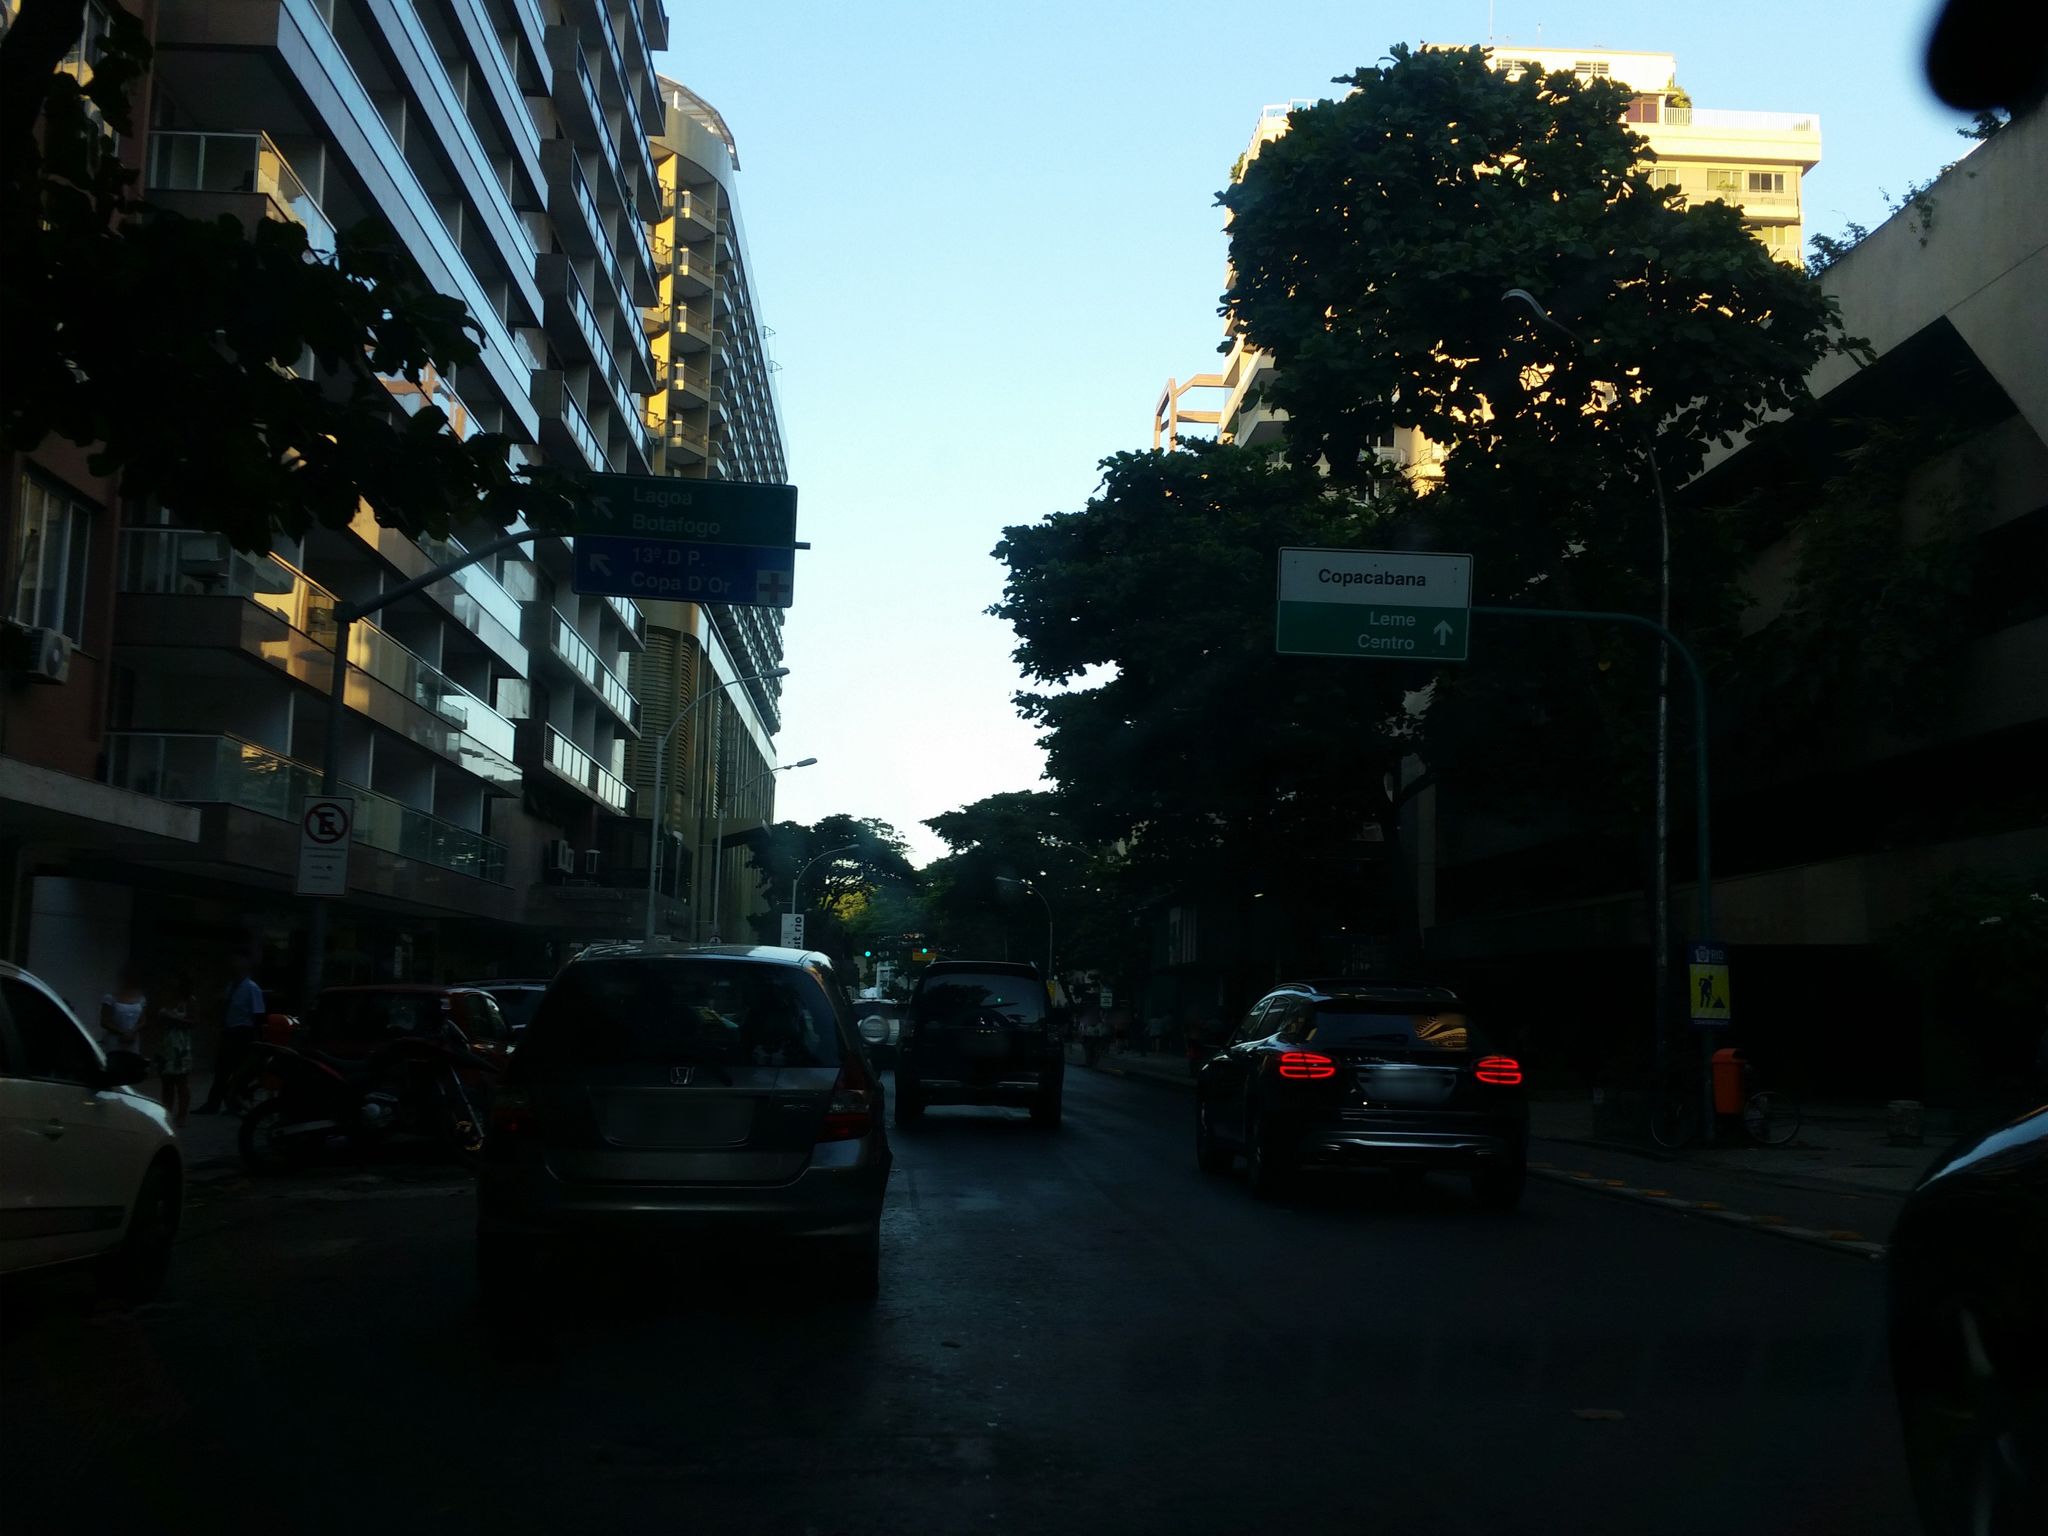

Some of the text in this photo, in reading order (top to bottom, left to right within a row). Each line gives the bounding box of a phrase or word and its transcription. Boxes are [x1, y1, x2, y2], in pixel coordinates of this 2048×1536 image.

[633, 486, 692, 508] Lagoa
[632, 513, 720, 538] Botafogo
[632, 571, 681, 592] Copa
[1319, 569, 1426, 587] Copacabana
[1369, 611, 1415, 627] Leme
[1358, 633, 1415, 651] Centro
